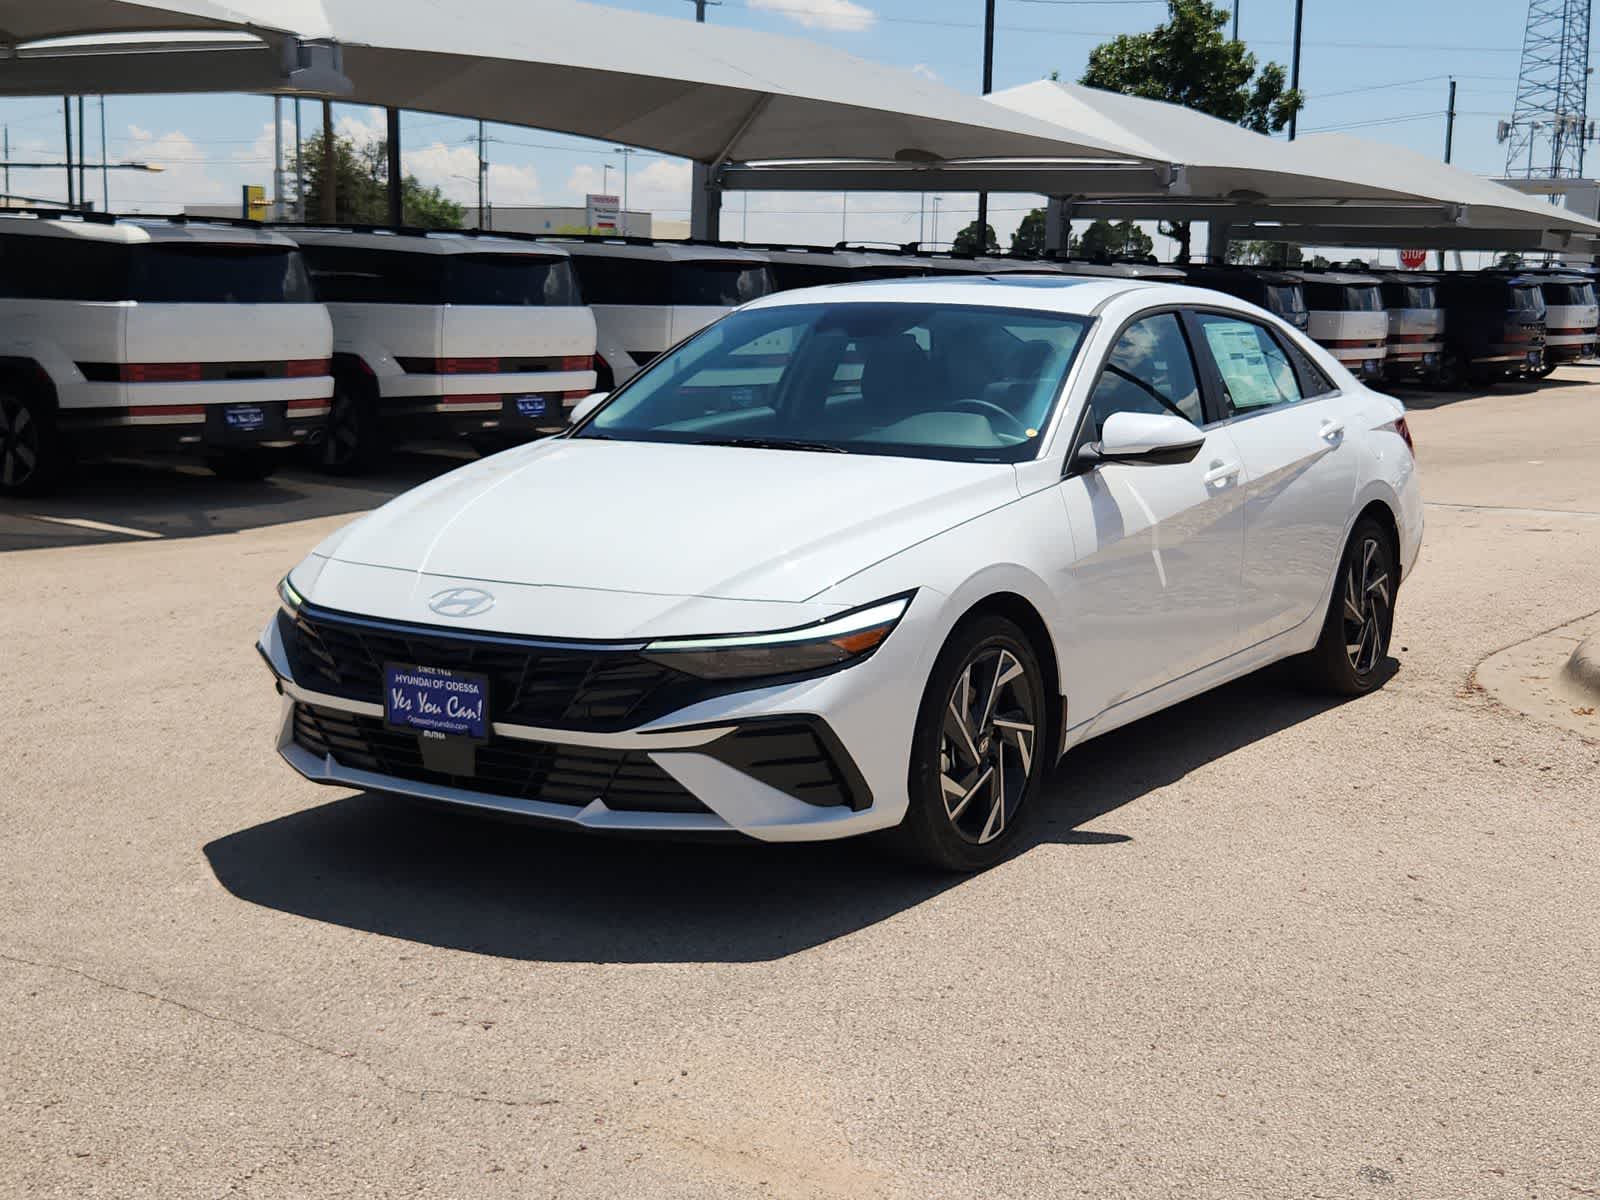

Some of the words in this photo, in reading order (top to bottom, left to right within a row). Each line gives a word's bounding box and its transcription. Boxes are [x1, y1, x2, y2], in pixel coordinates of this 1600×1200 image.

[1402, 249, 1425, 259] STOP
[395, 674, 432, 688] HYUNDAI
[433, 680, 444, 689] OF
[446, 681, 480, 694] ODESSA
[392, 687, 412, 711] Yes
[418, 691, 442, 714] You
[447, 695, 483, 721] Can!
